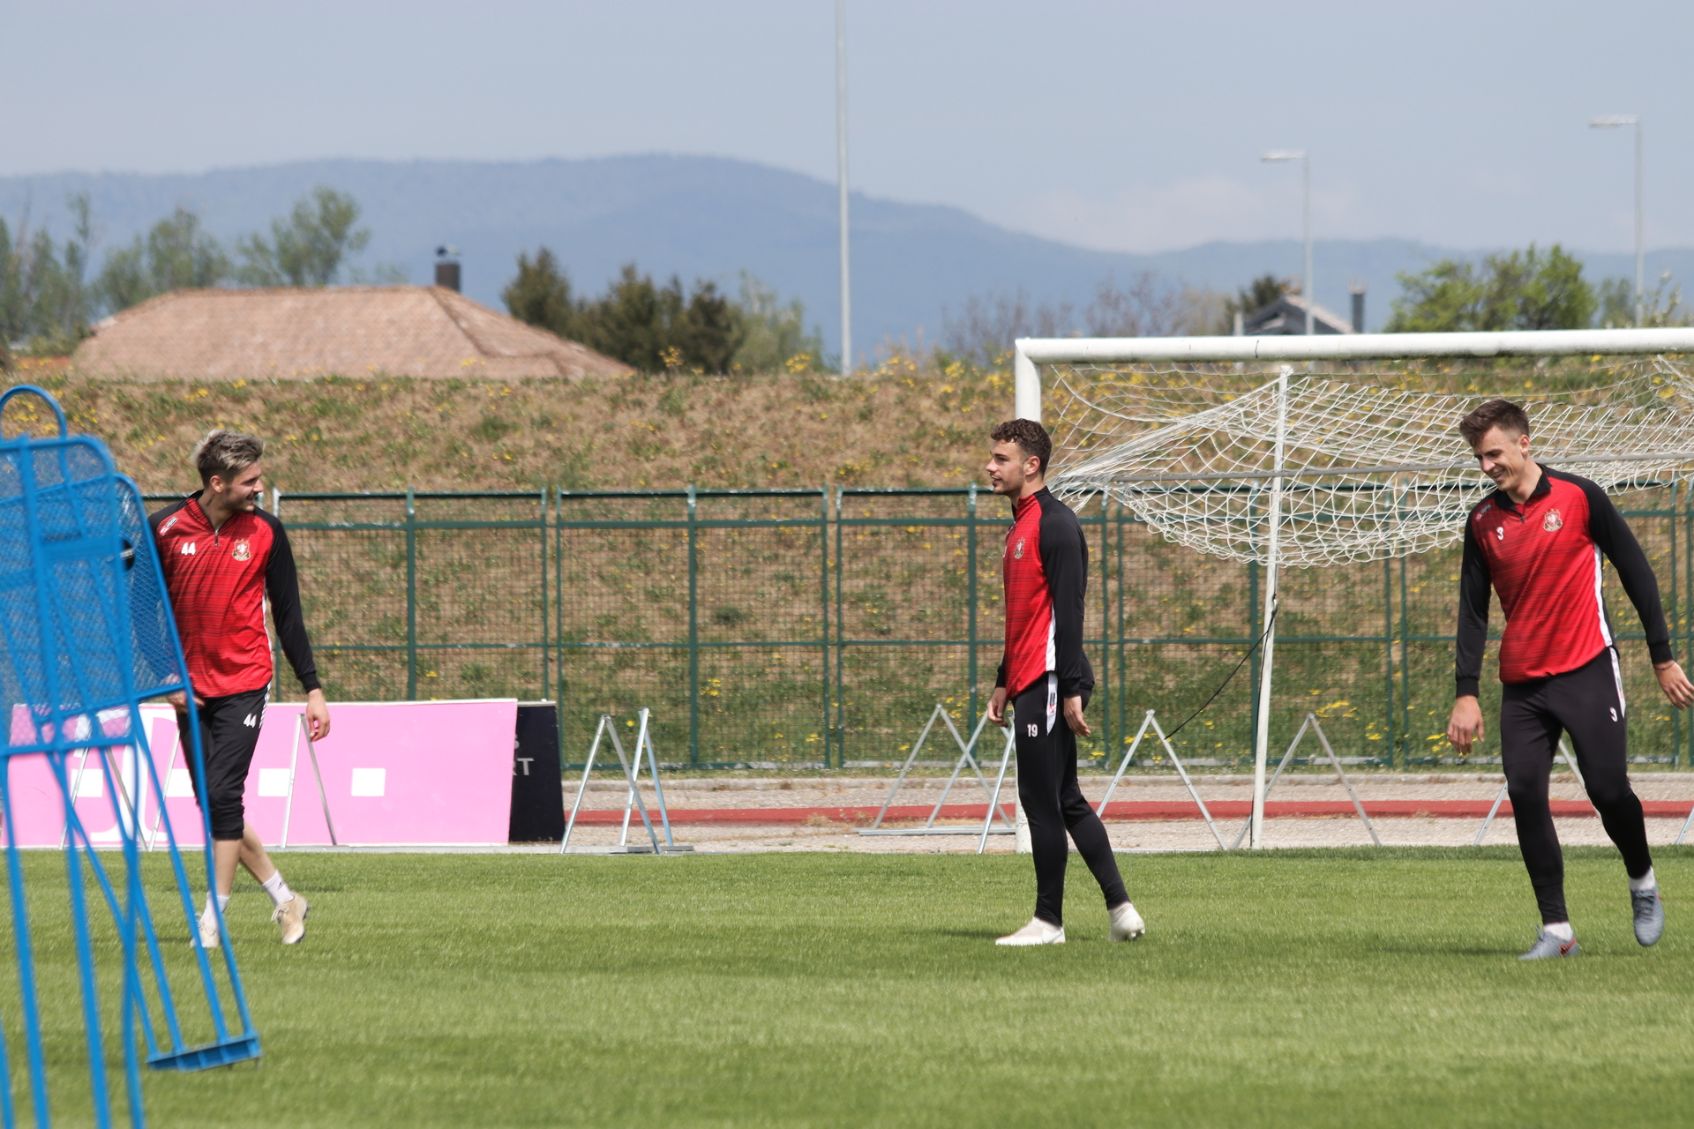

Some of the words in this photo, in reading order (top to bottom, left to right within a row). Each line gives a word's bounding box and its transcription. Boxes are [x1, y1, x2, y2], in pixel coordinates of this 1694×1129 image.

[1496, 526, 1504, 540] 3
[181, 541, 196, 556] 44
[243, 713, 257, 728] 44
[1027, 723, 1038, 738] 19
